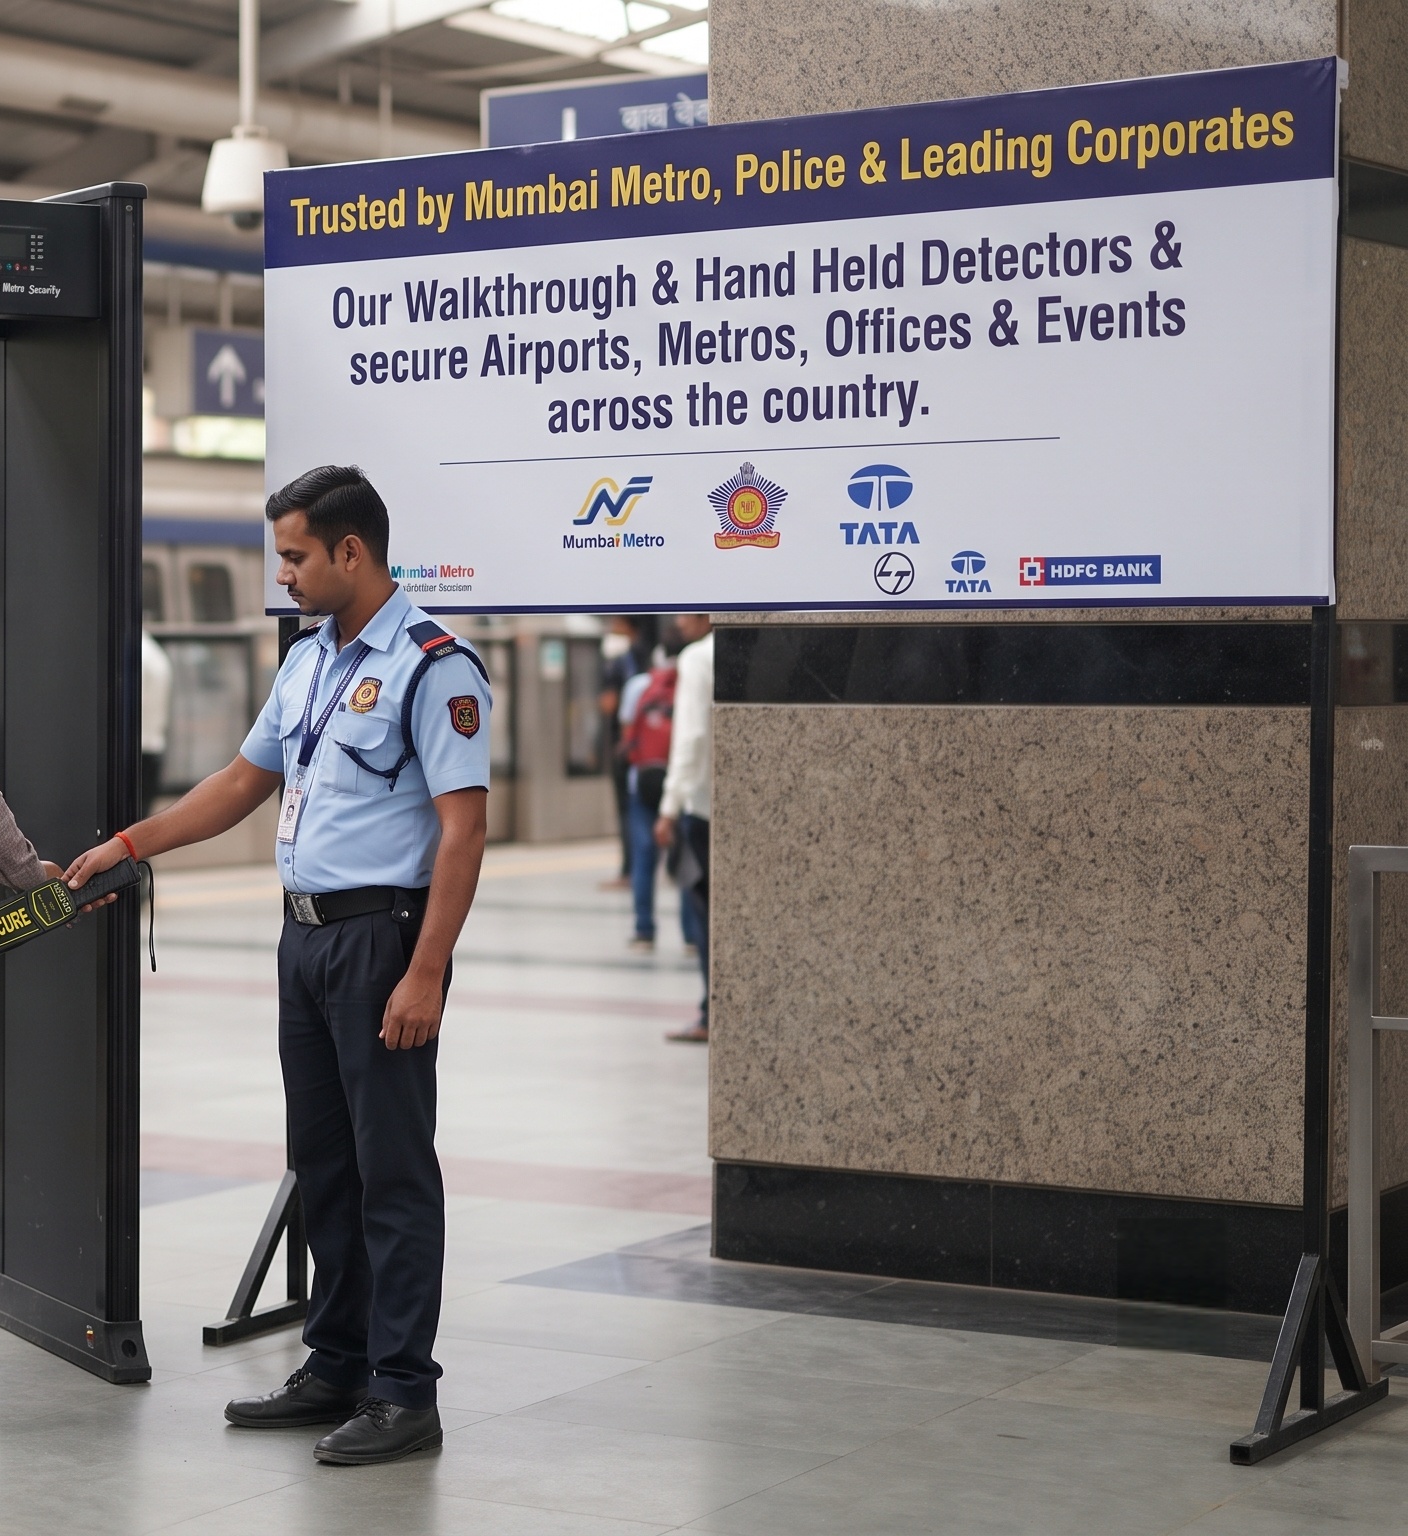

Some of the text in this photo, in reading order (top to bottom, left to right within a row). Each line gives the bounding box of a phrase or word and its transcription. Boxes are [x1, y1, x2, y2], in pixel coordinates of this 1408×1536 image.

[290, 107, 1295, 236] Trusted by Mumbai Metro, Police & Leading Corporates
[332, 220, 1183, 330] Our Walkthrough & Hand Held Detectors &
[350, 290, 1187, 386] secure Airports, Metros, Offices & Events
[548, 373, 929, 434] across the country.
[562, 532, 665, 549] Mumbai Metro
[839, 521, 921, 545] TATA
[439, 564, 475, 578] Metro
[1049, 562, 1154, 579] HDFC BANK
[944, 579, 993, 593] TATA
